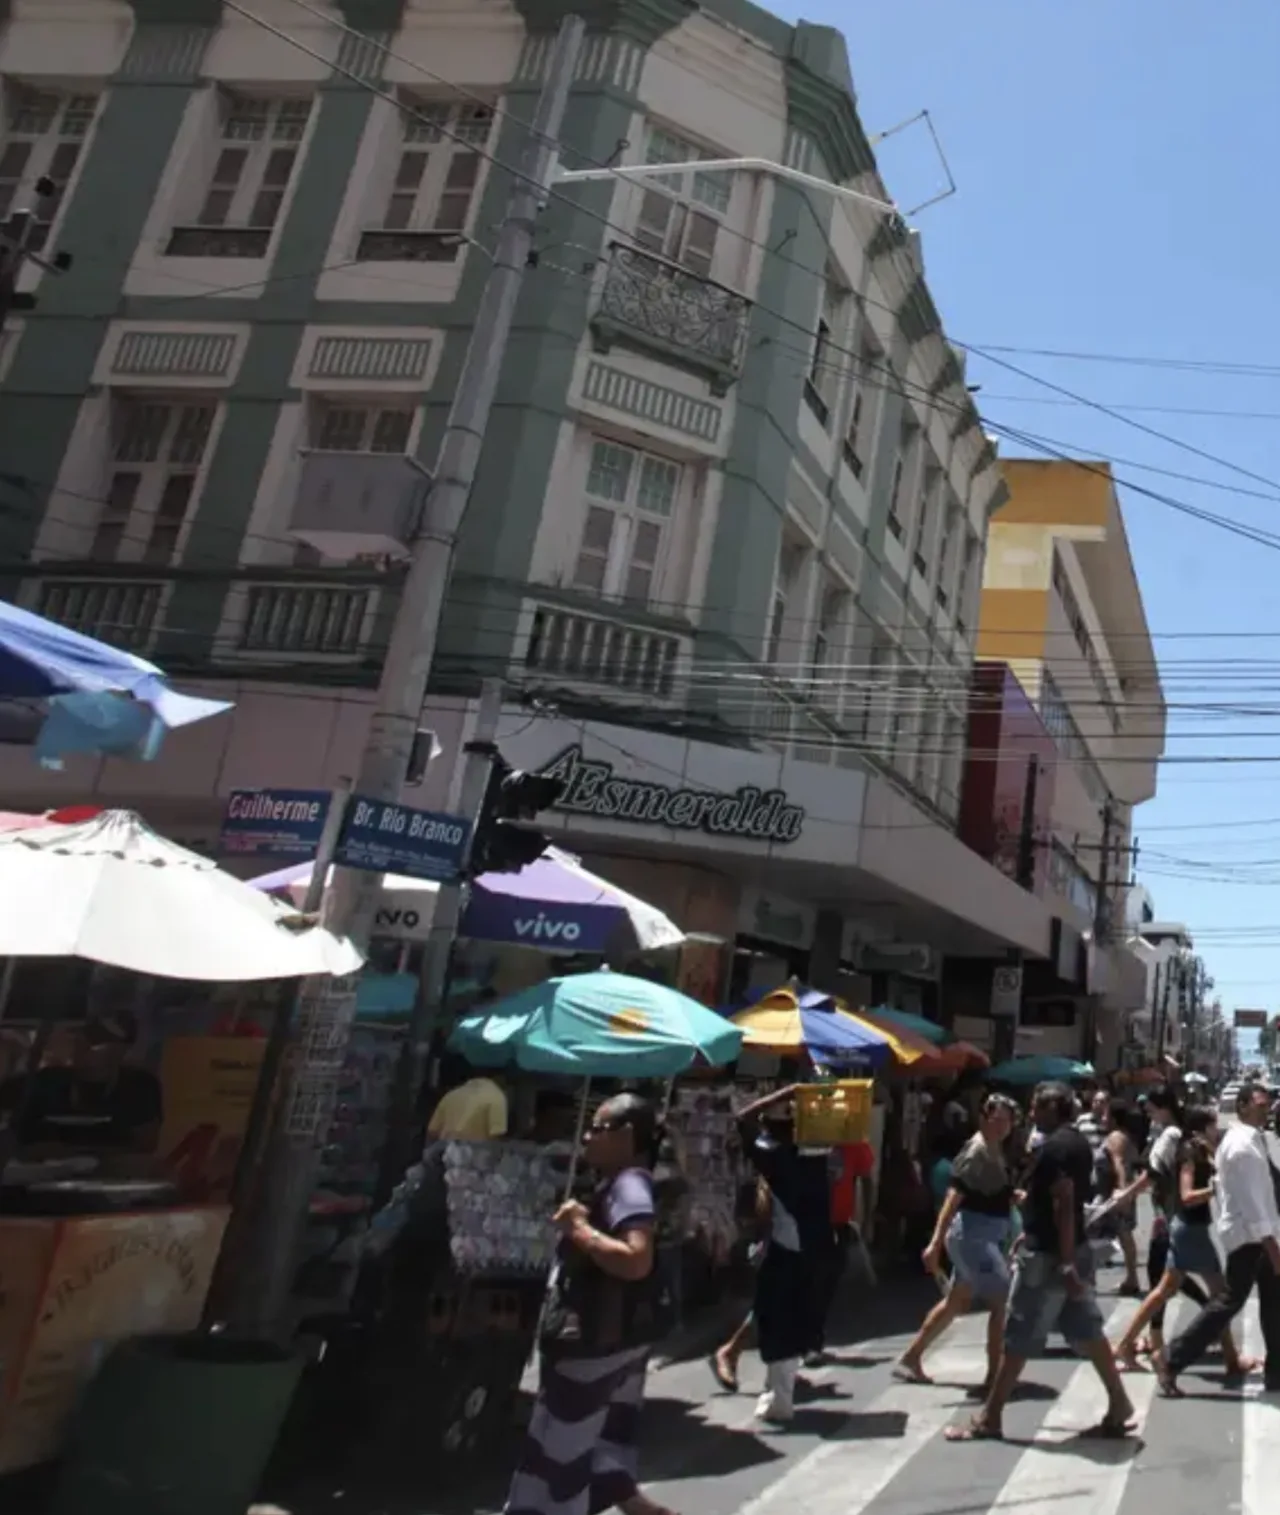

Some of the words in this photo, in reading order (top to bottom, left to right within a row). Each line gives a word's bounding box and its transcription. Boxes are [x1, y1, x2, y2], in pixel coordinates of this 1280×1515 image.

[228, 793, 321, 823] Guilherme
[379, 807, 405, 834] Rio
[408, 813, 464, 845] Branco
[513, 912, 580, 940] vivo
